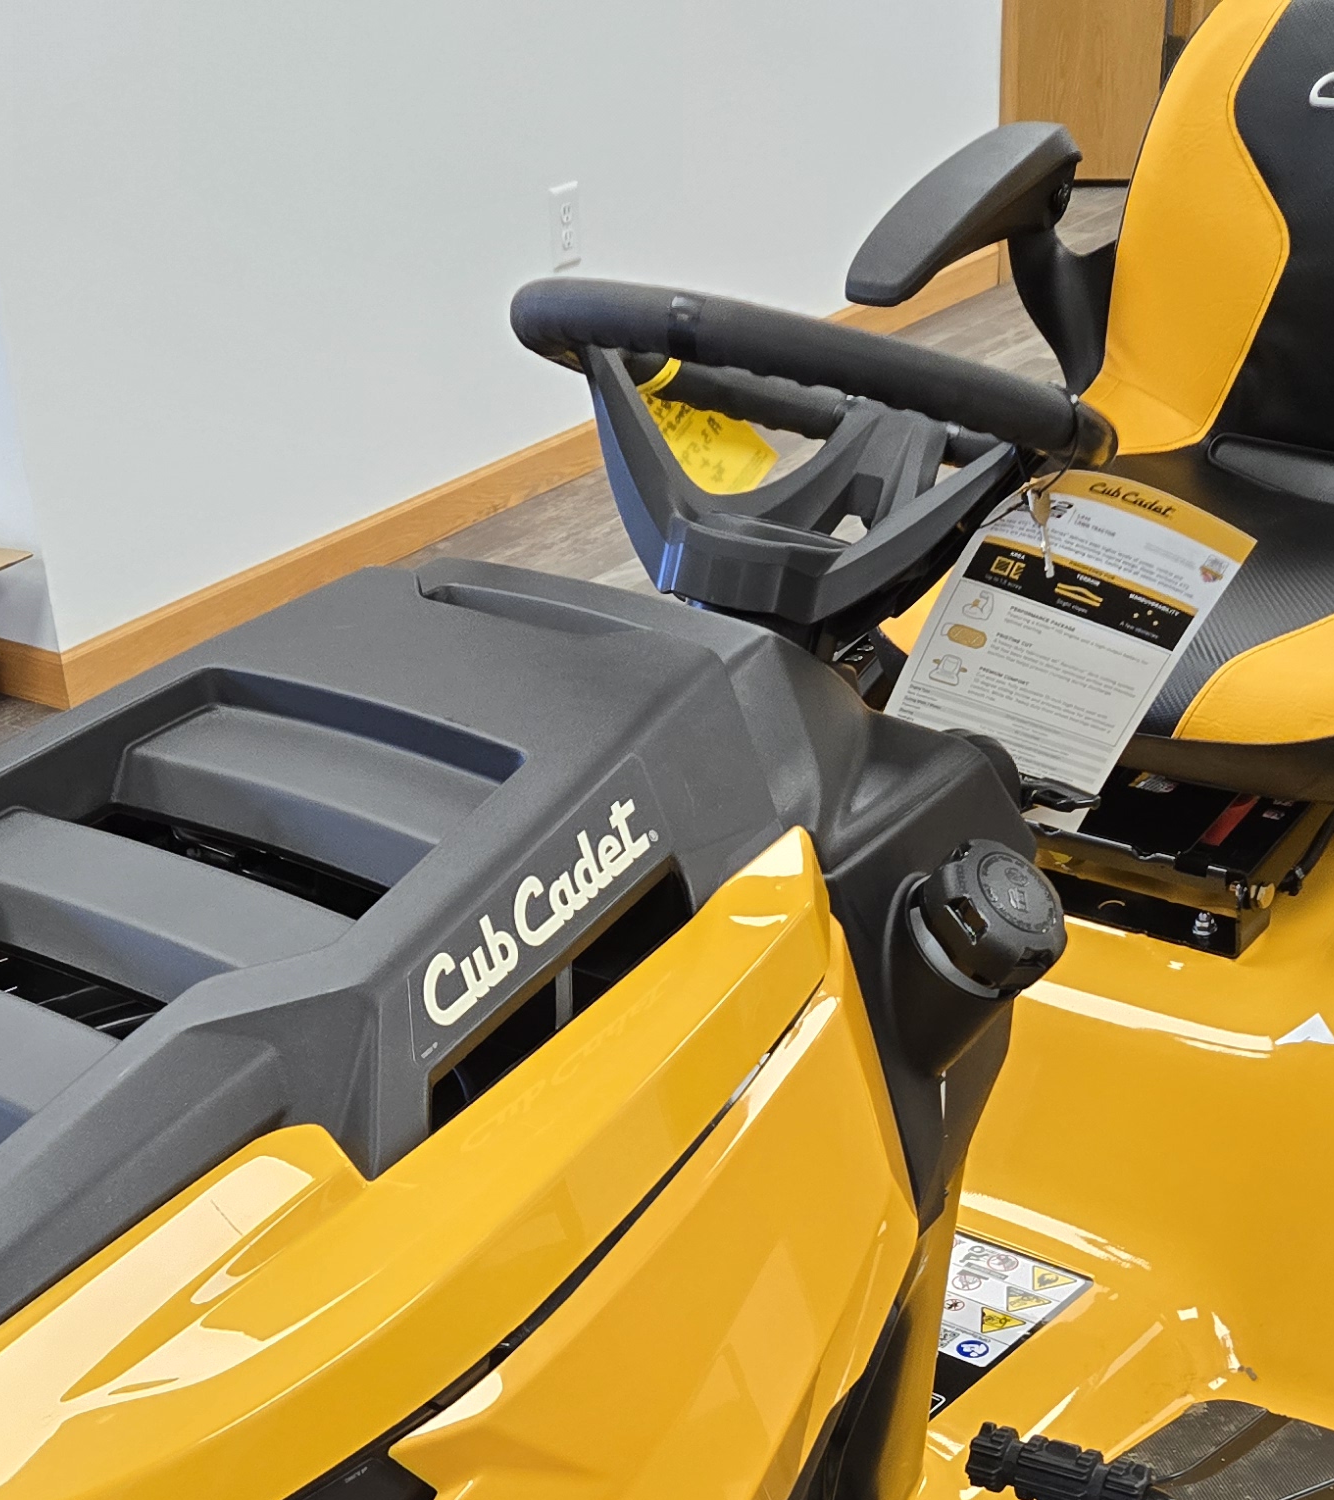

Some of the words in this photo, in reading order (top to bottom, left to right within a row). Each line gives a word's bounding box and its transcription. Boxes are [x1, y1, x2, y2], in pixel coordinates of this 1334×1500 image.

[1089, 481, 1121, 501] Cub
[1121, 491, 1176, 518] Cadet
[423, 913, 519, 1027] Cub
[513, 797, 652, 947] Cadet
